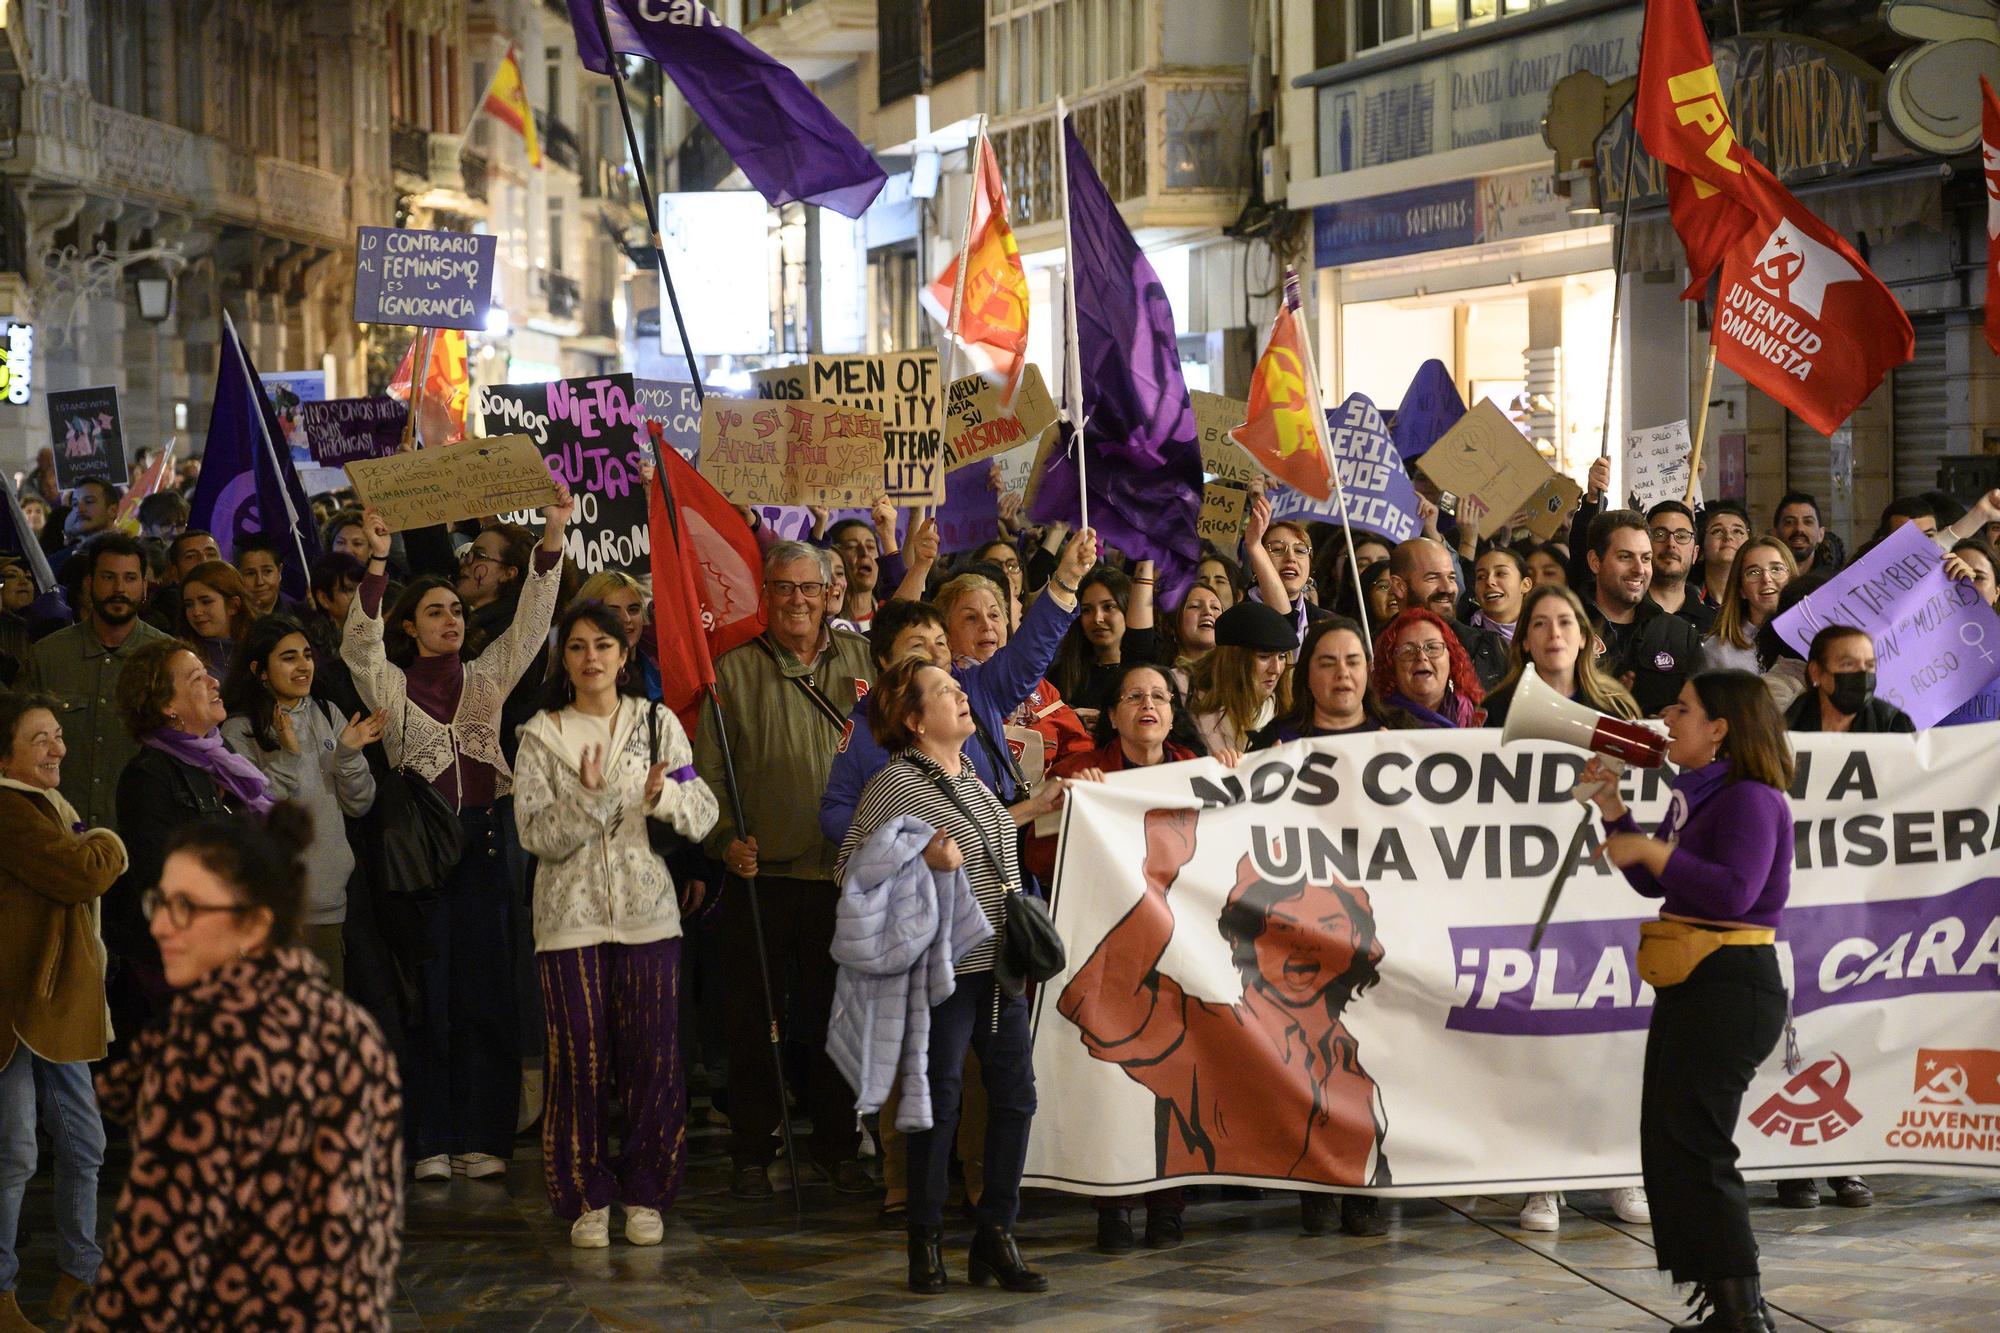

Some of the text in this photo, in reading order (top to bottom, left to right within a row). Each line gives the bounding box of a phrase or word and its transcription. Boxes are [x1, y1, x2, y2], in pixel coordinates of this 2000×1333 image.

[361, 233, 479, 255] LO CONTRARIO
[359, 258, 375, 273] AL
[387, 281, 440, 291] ES LA
[1725, 282, 1822, 355] JUVENTUD
[1721, 304, 1812, 382] OMUNISTA
[758, 378, 804, 400] NOS
[813, 358, 938, 395] MEN OF
[478, 384, 549, 445] SOMOS
[634, 388, 673, 407] OMOS
[822, 409, 884, 443] CREO
[962, 409, 982, 428] SU
[705, 436, 781, 466] AMOR
[544, 441, 642, 500] RUJAS
[712, 465, 728, 491] TE
[733, 465, 768, 490] PASA
[1847, 546, 1944, 615] TAMBIEN
[1912, 578, 1980, 638] MUJERES
[1910, 650, 1959, 696] ACOSO
[1190, 751, 1340, 808] NOS
[1826, 750, 1879, 801] A
[1250, 823, 1418, 882] UNA
[1430, 823, 1613, 880] VIDA
[1760, 1114, 1849, 1146] PCE
